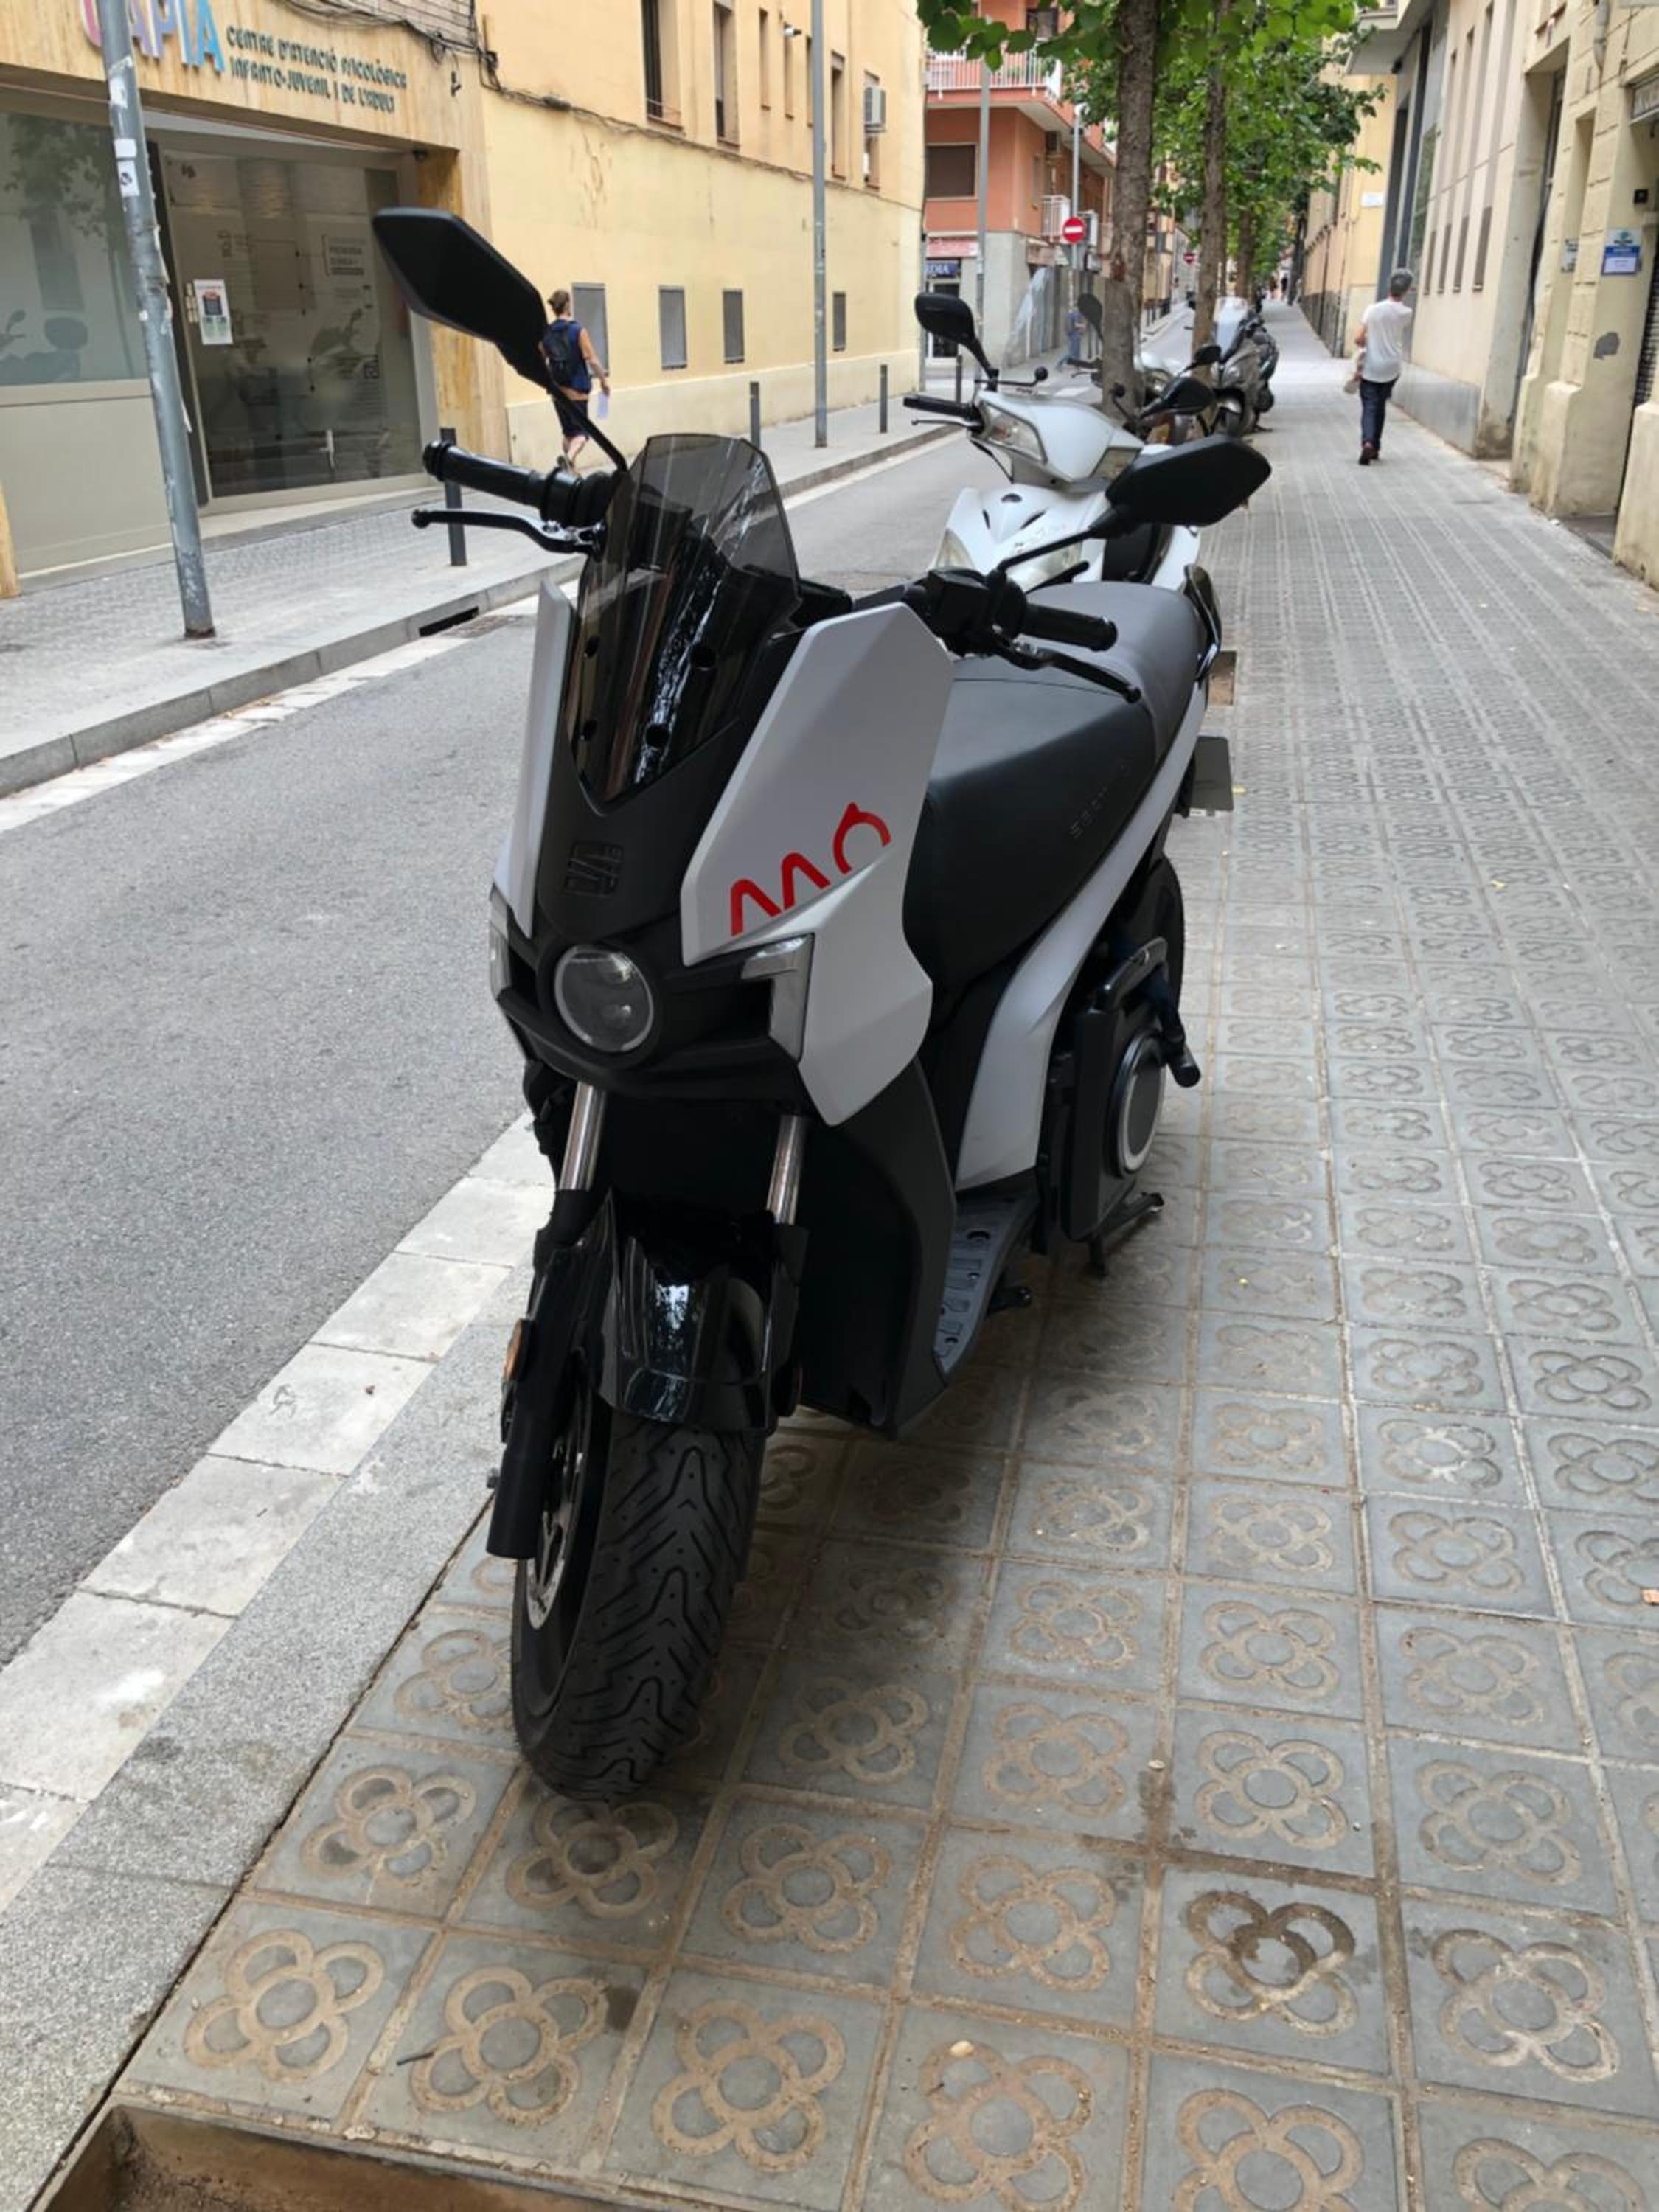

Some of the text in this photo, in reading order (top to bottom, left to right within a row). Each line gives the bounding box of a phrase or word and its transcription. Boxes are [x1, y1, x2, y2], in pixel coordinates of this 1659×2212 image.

[226, 24, 274, 57] CENTRE
[230, 56, 331, 99] INFANTO-JUVENIL
[341, 83, 355, 105] DE
